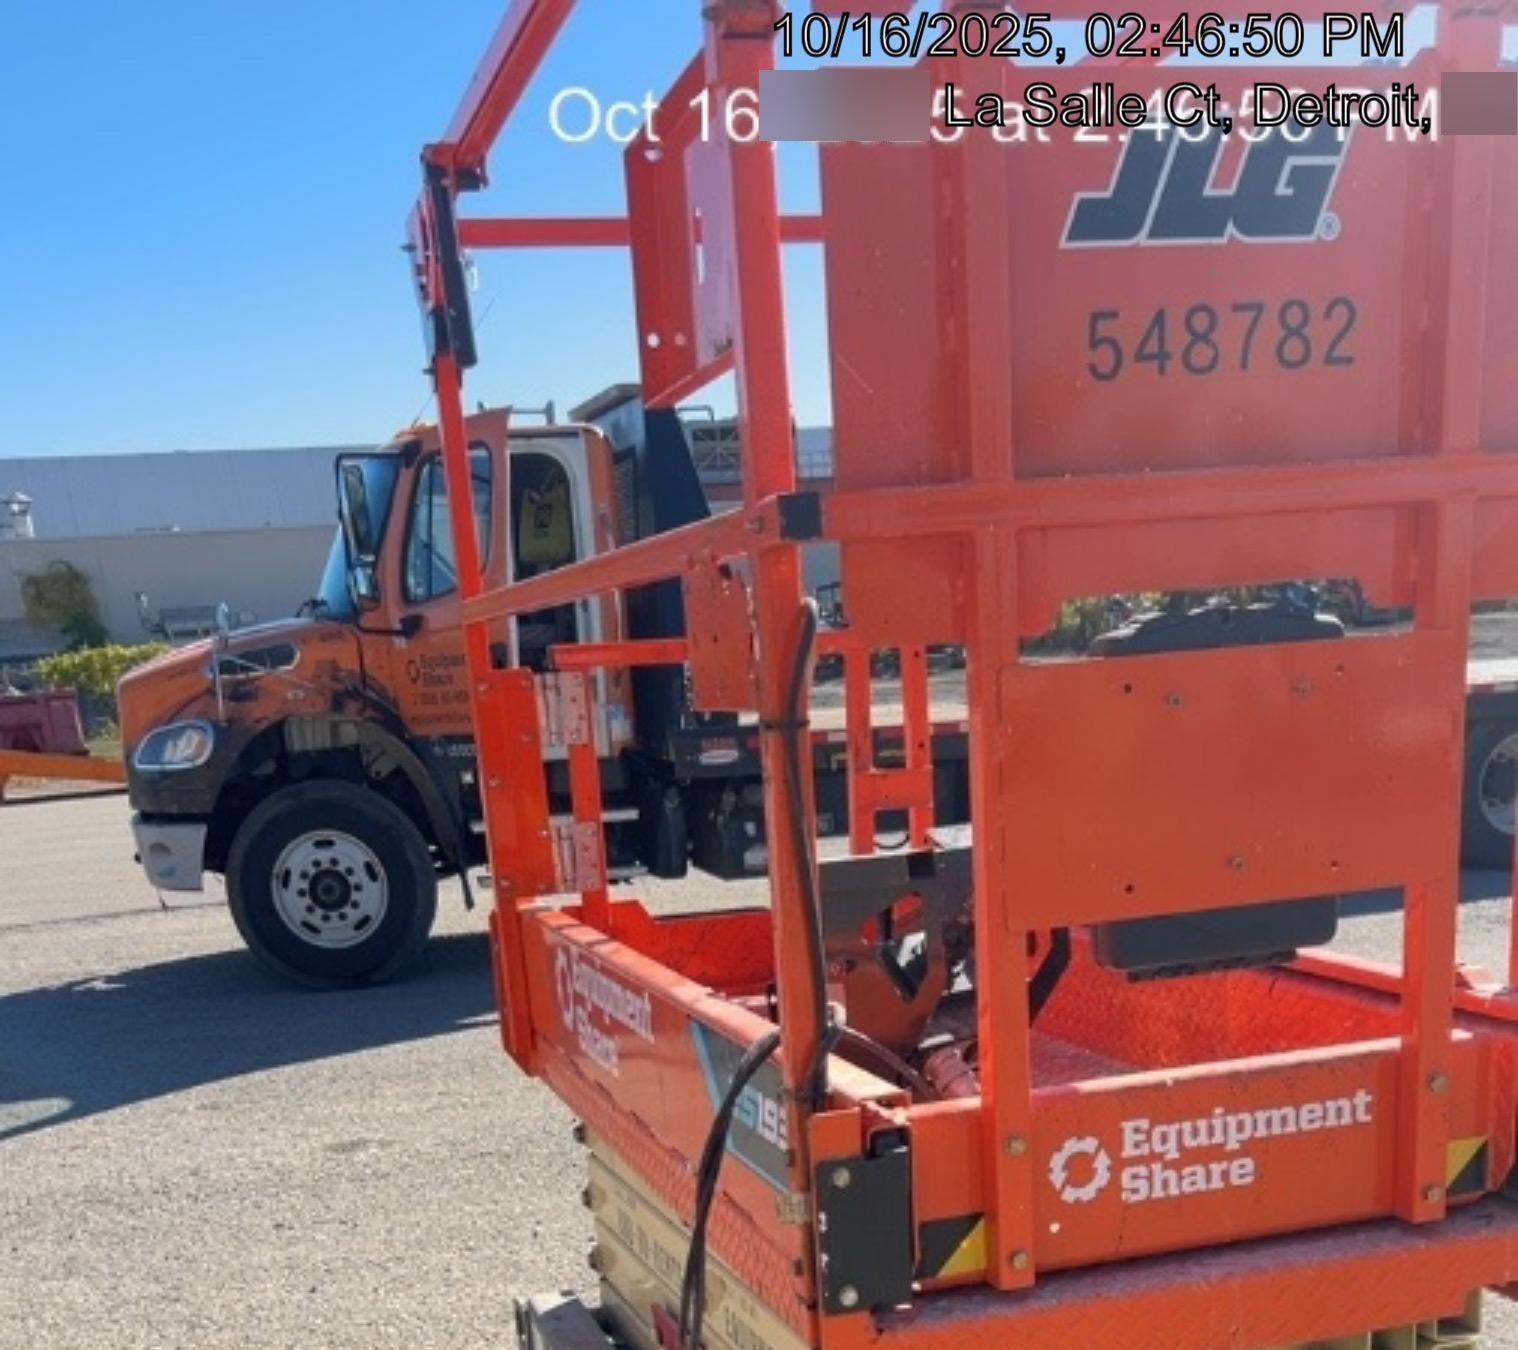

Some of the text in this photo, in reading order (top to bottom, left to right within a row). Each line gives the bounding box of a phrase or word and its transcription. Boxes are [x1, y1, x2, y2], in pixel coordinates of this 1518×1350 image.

[1058, 115, 1352, 249] JLG
[1086, 296, 1358, 382] 548782
[1120, 1088, 1373, 1160] Equipment
[1120, 1156, 1256, 1203] Share
